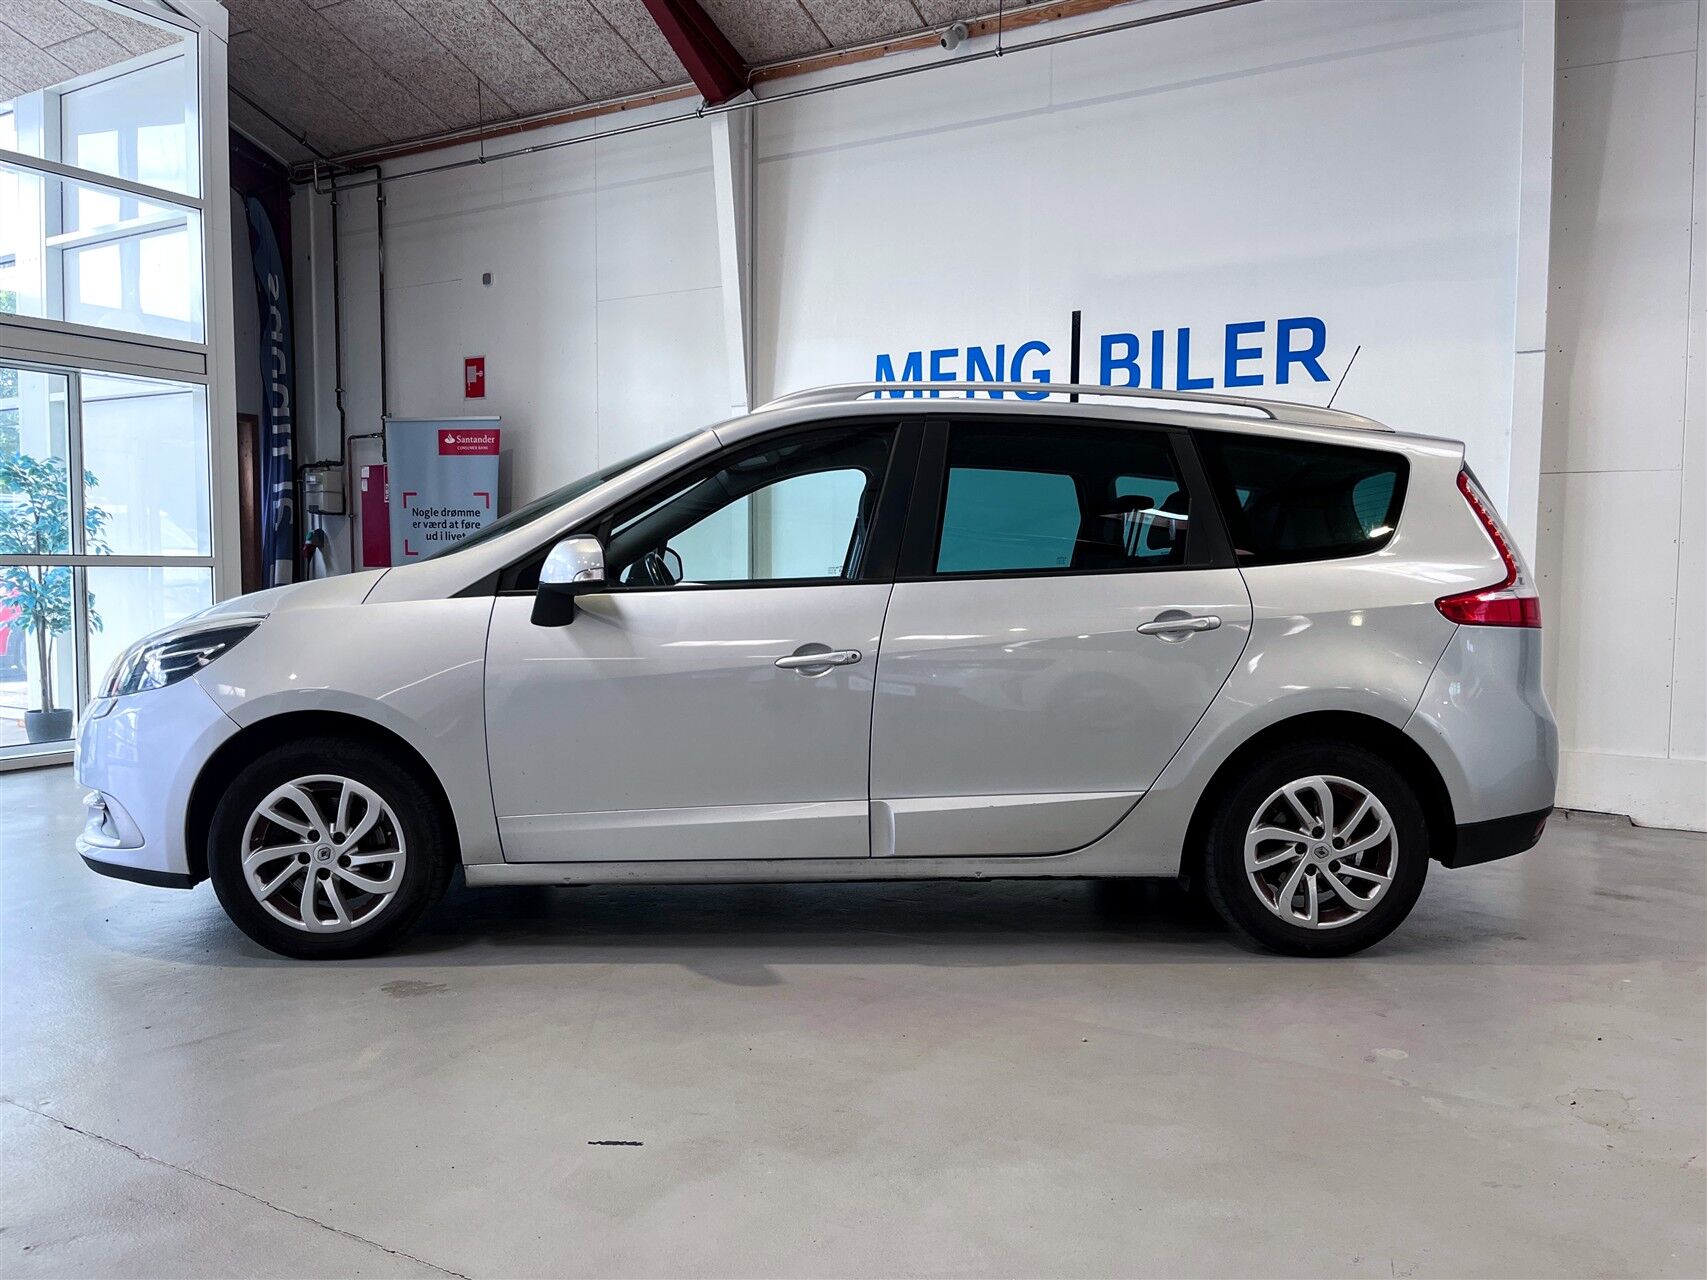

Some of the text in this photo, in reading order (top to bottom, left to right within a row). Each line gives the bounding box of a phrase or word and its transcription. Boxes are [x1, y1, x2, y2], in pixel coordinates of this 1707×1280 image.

[873, 316, 1331, 401] MENG BILER
[456, 434, 496, 444] Santander
[412, 507, 481, 519] Nogle drømme
[412, 519, 481, 530] er værd at føre
[426, 531, 438, 541] ud
